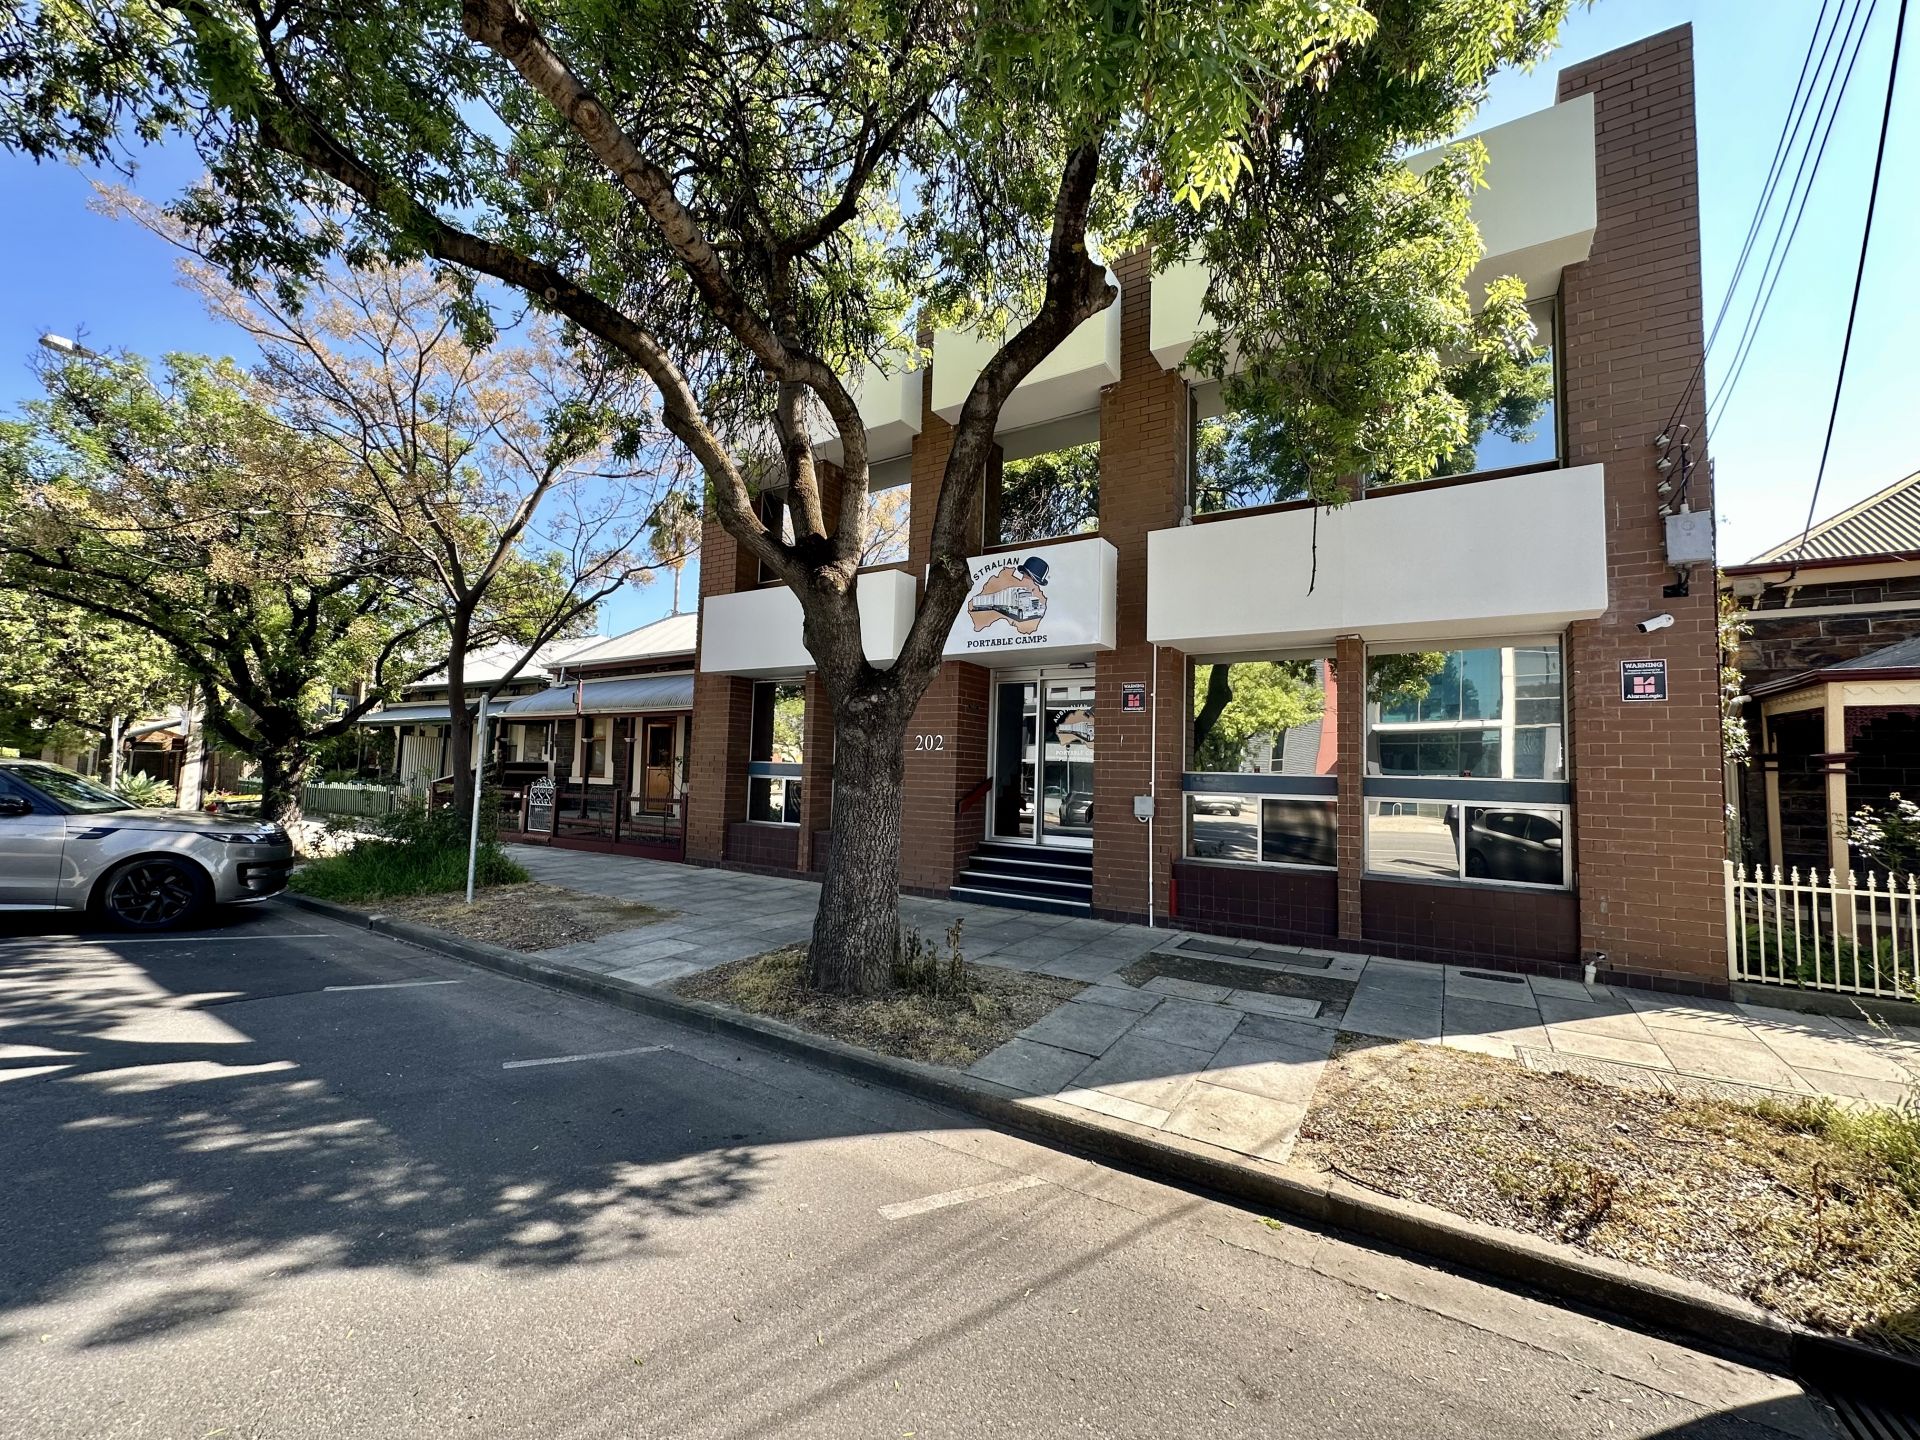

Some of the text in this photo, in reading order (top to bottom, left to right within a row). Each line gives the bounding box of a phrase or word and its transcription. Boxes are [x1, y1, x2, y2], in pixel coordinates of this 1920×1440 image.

[973, 557, 1020, 581] STRALIAN
[967, 635, 1048, 648] PORTABLE CAMPS
[915, 734, 944, 750] 202
